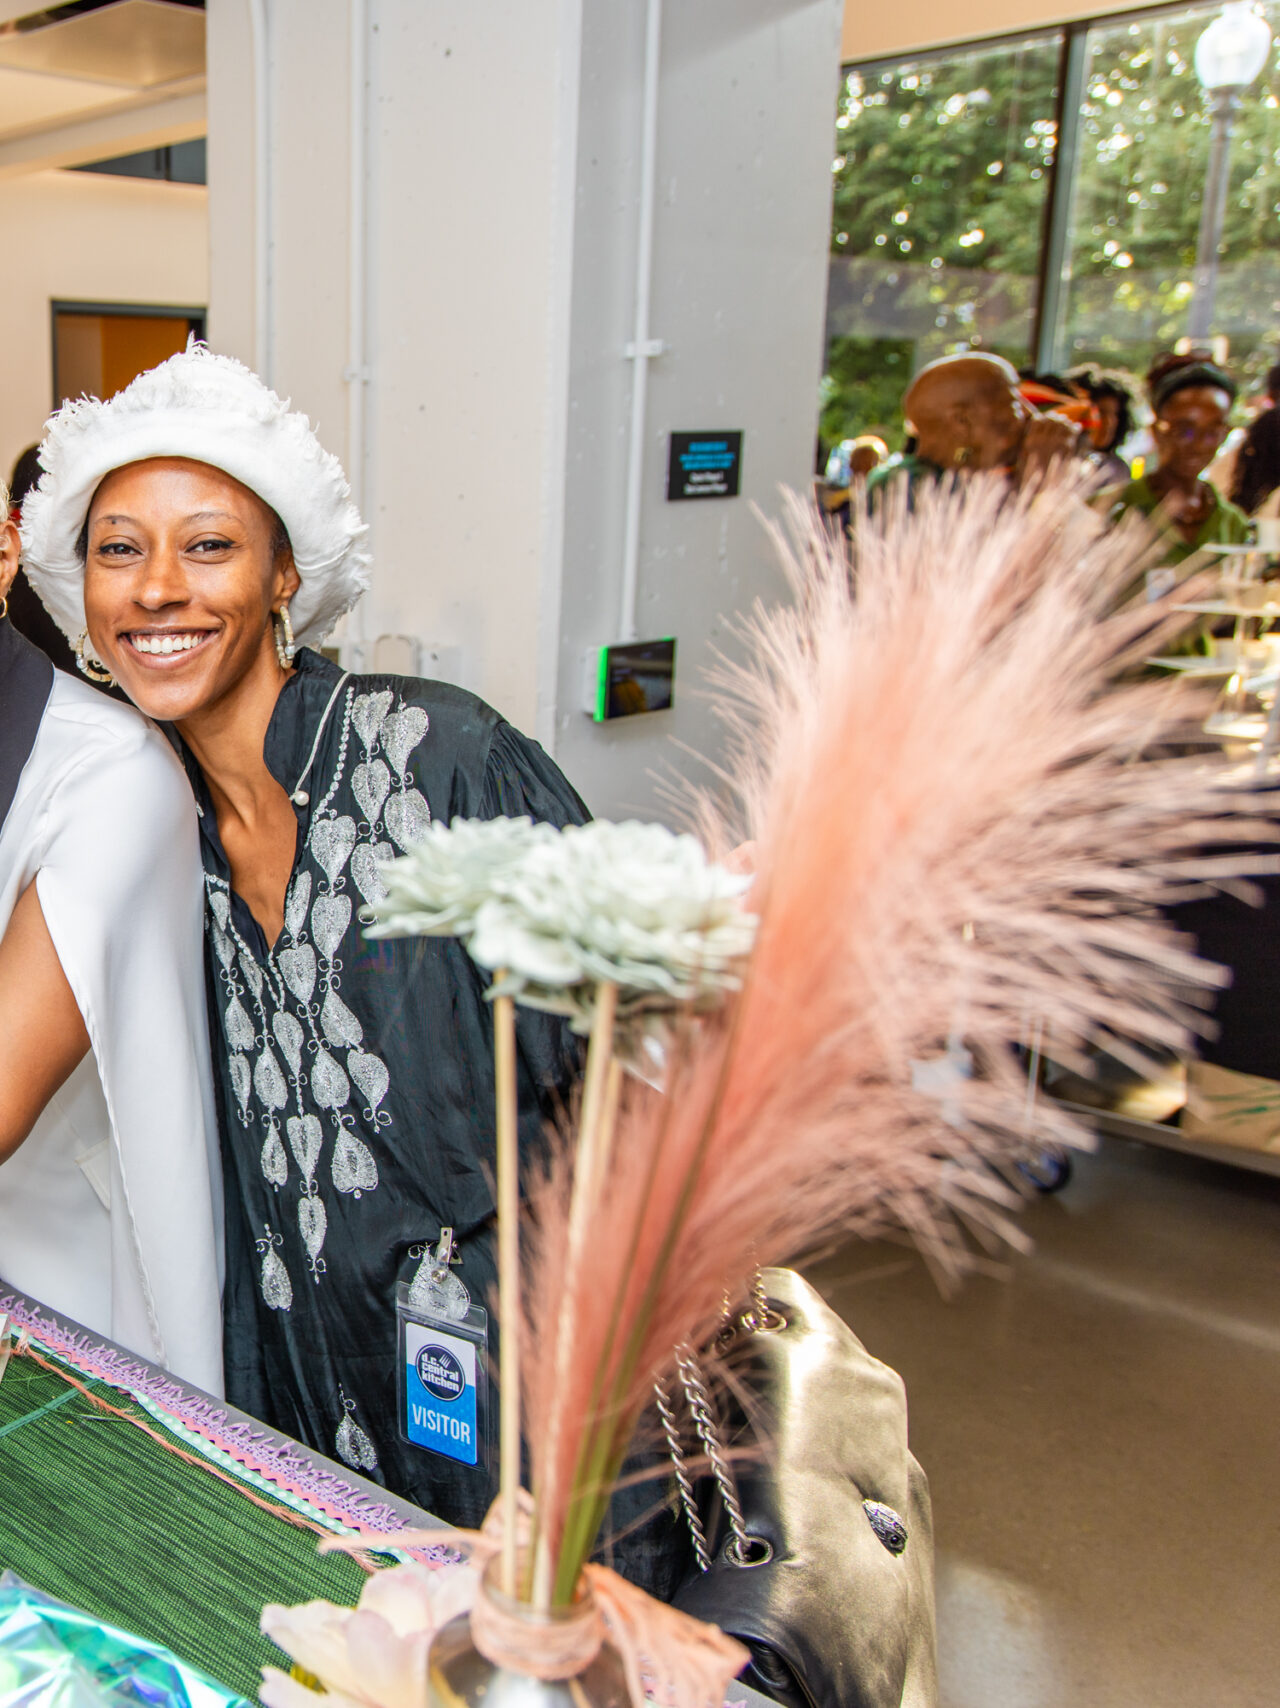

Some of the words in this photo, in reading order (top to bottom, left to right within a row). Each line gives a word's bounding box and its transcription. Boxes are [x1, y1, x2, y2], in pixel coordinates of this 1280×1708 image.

[421, 1352, 440, 1367] d.c.
[421, 1361, 459, 1382] central
[421, 1369, 459, 1392] kitchen
[412, 1403, 471, 1445] VISITOR
